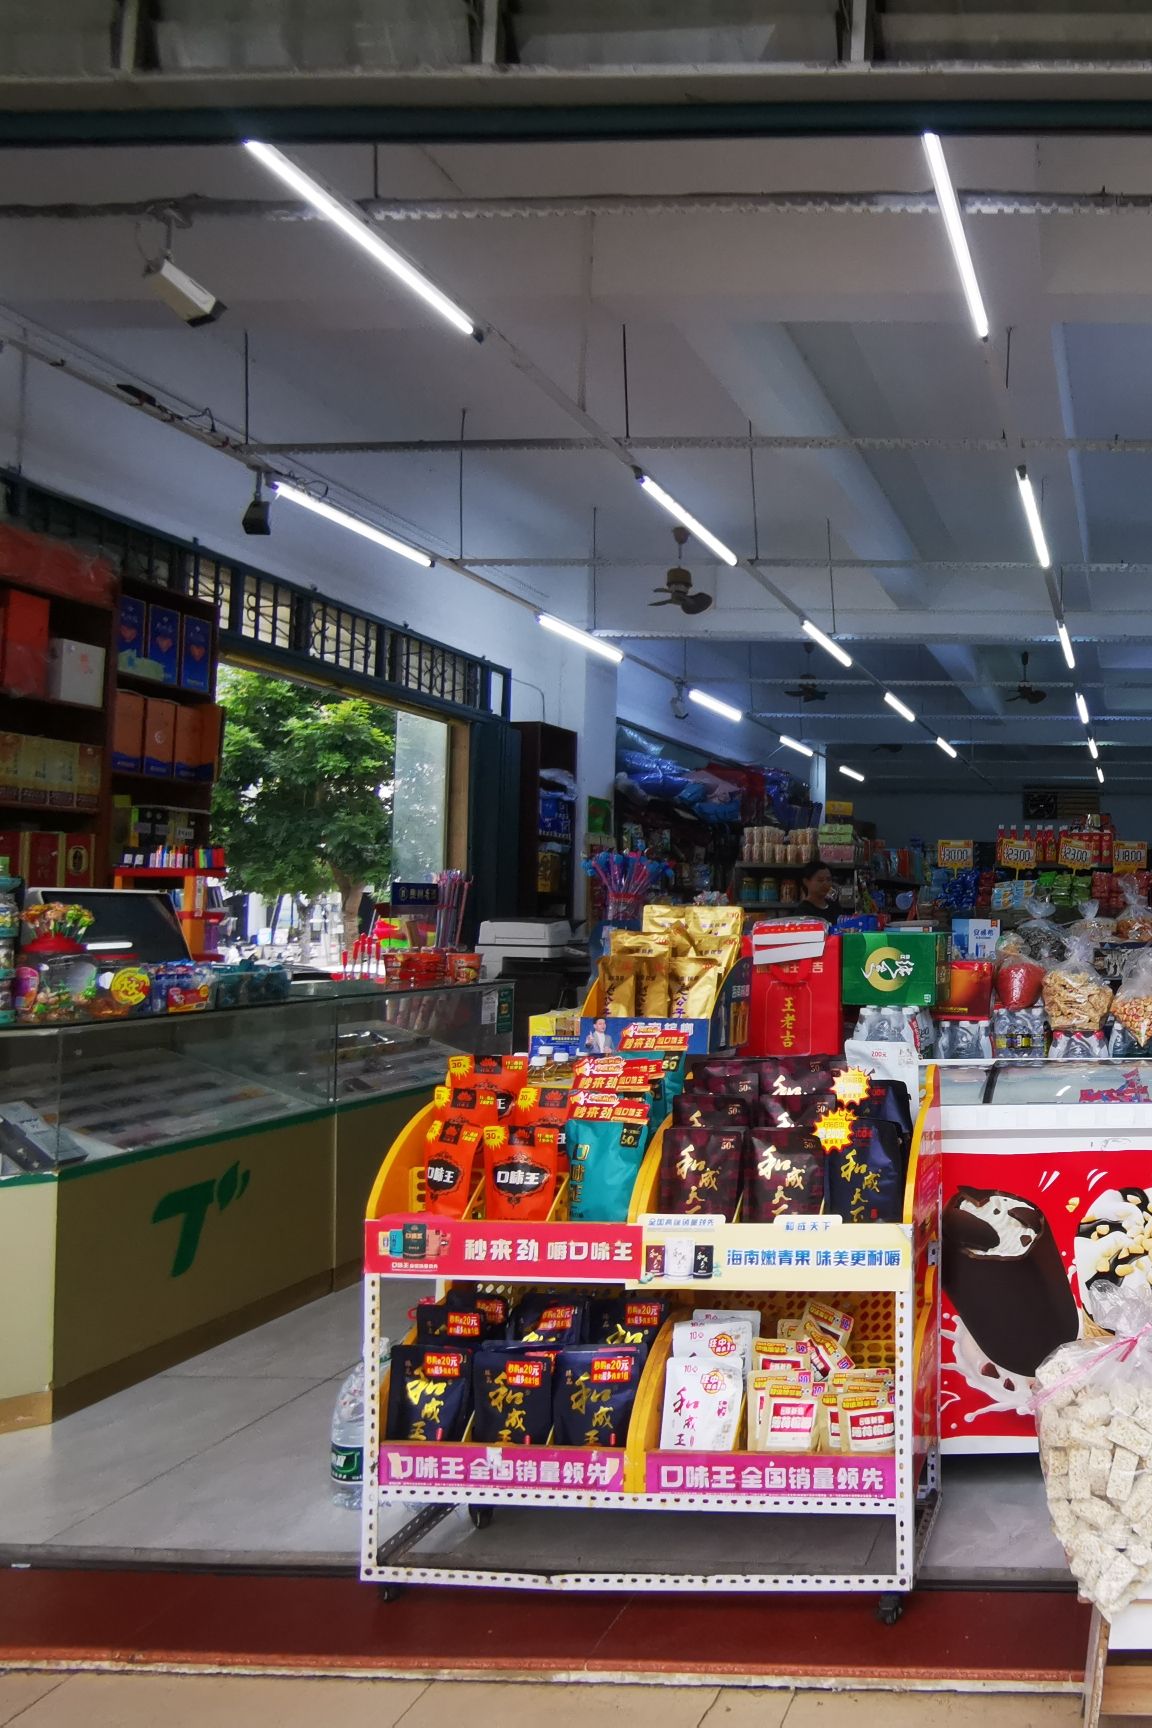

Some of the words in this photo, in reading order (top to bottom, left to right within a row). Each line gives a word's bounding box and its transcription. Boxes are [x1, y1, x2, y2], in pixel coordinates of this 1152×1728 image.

[780, 996, 796, 1048] 王老吉
[427, 1166, 454, 1184] 口味王
[496, 1170, 541, 1185] 口味王
[464, 1238, 540, 1262] 秒来劲
[547, 1240, 633, 1262] 嚼口味王
[726, 1249, 811, 1267] 海南嫩青果
[815, 1248, 902, 1267] 味美更耐嚼
